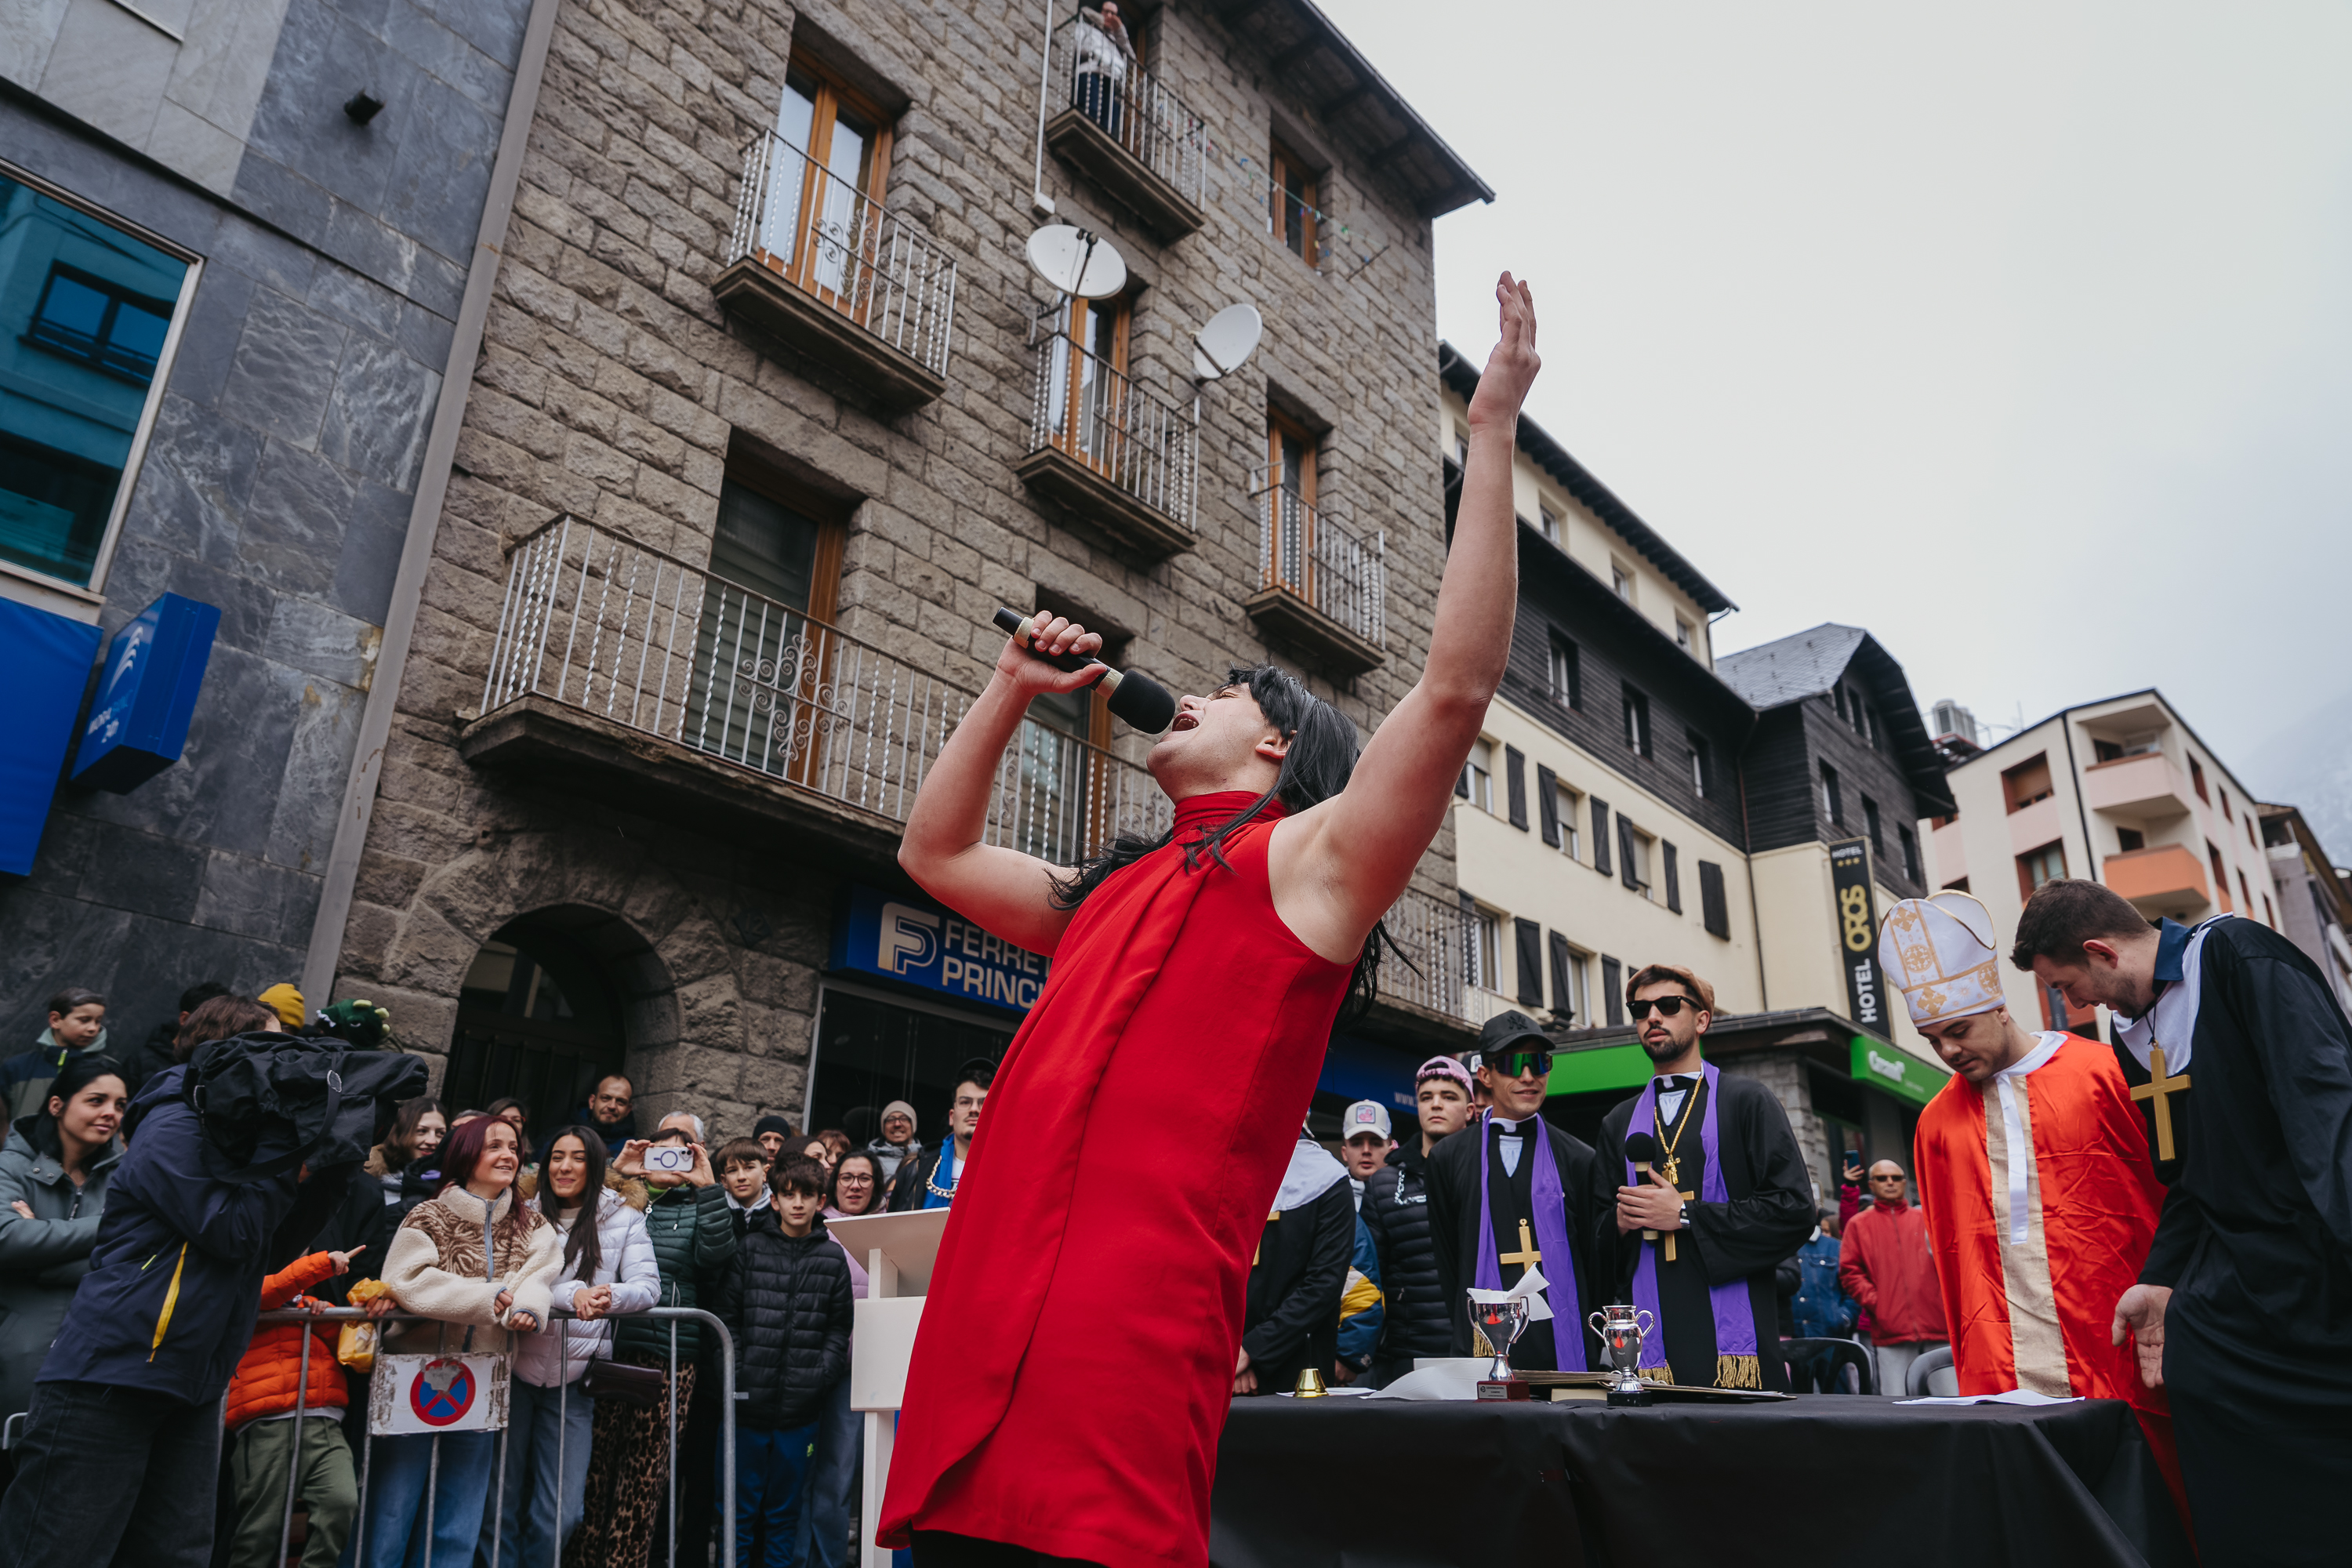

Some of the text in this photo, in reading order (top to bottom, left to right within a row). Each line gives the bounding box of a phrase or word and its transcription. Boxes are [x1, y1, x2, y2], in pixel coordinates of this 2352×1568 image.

[1831, 845, 1864, 859] HOTEL
[1839, 884, 1878, 1024] HOTEL OROS
